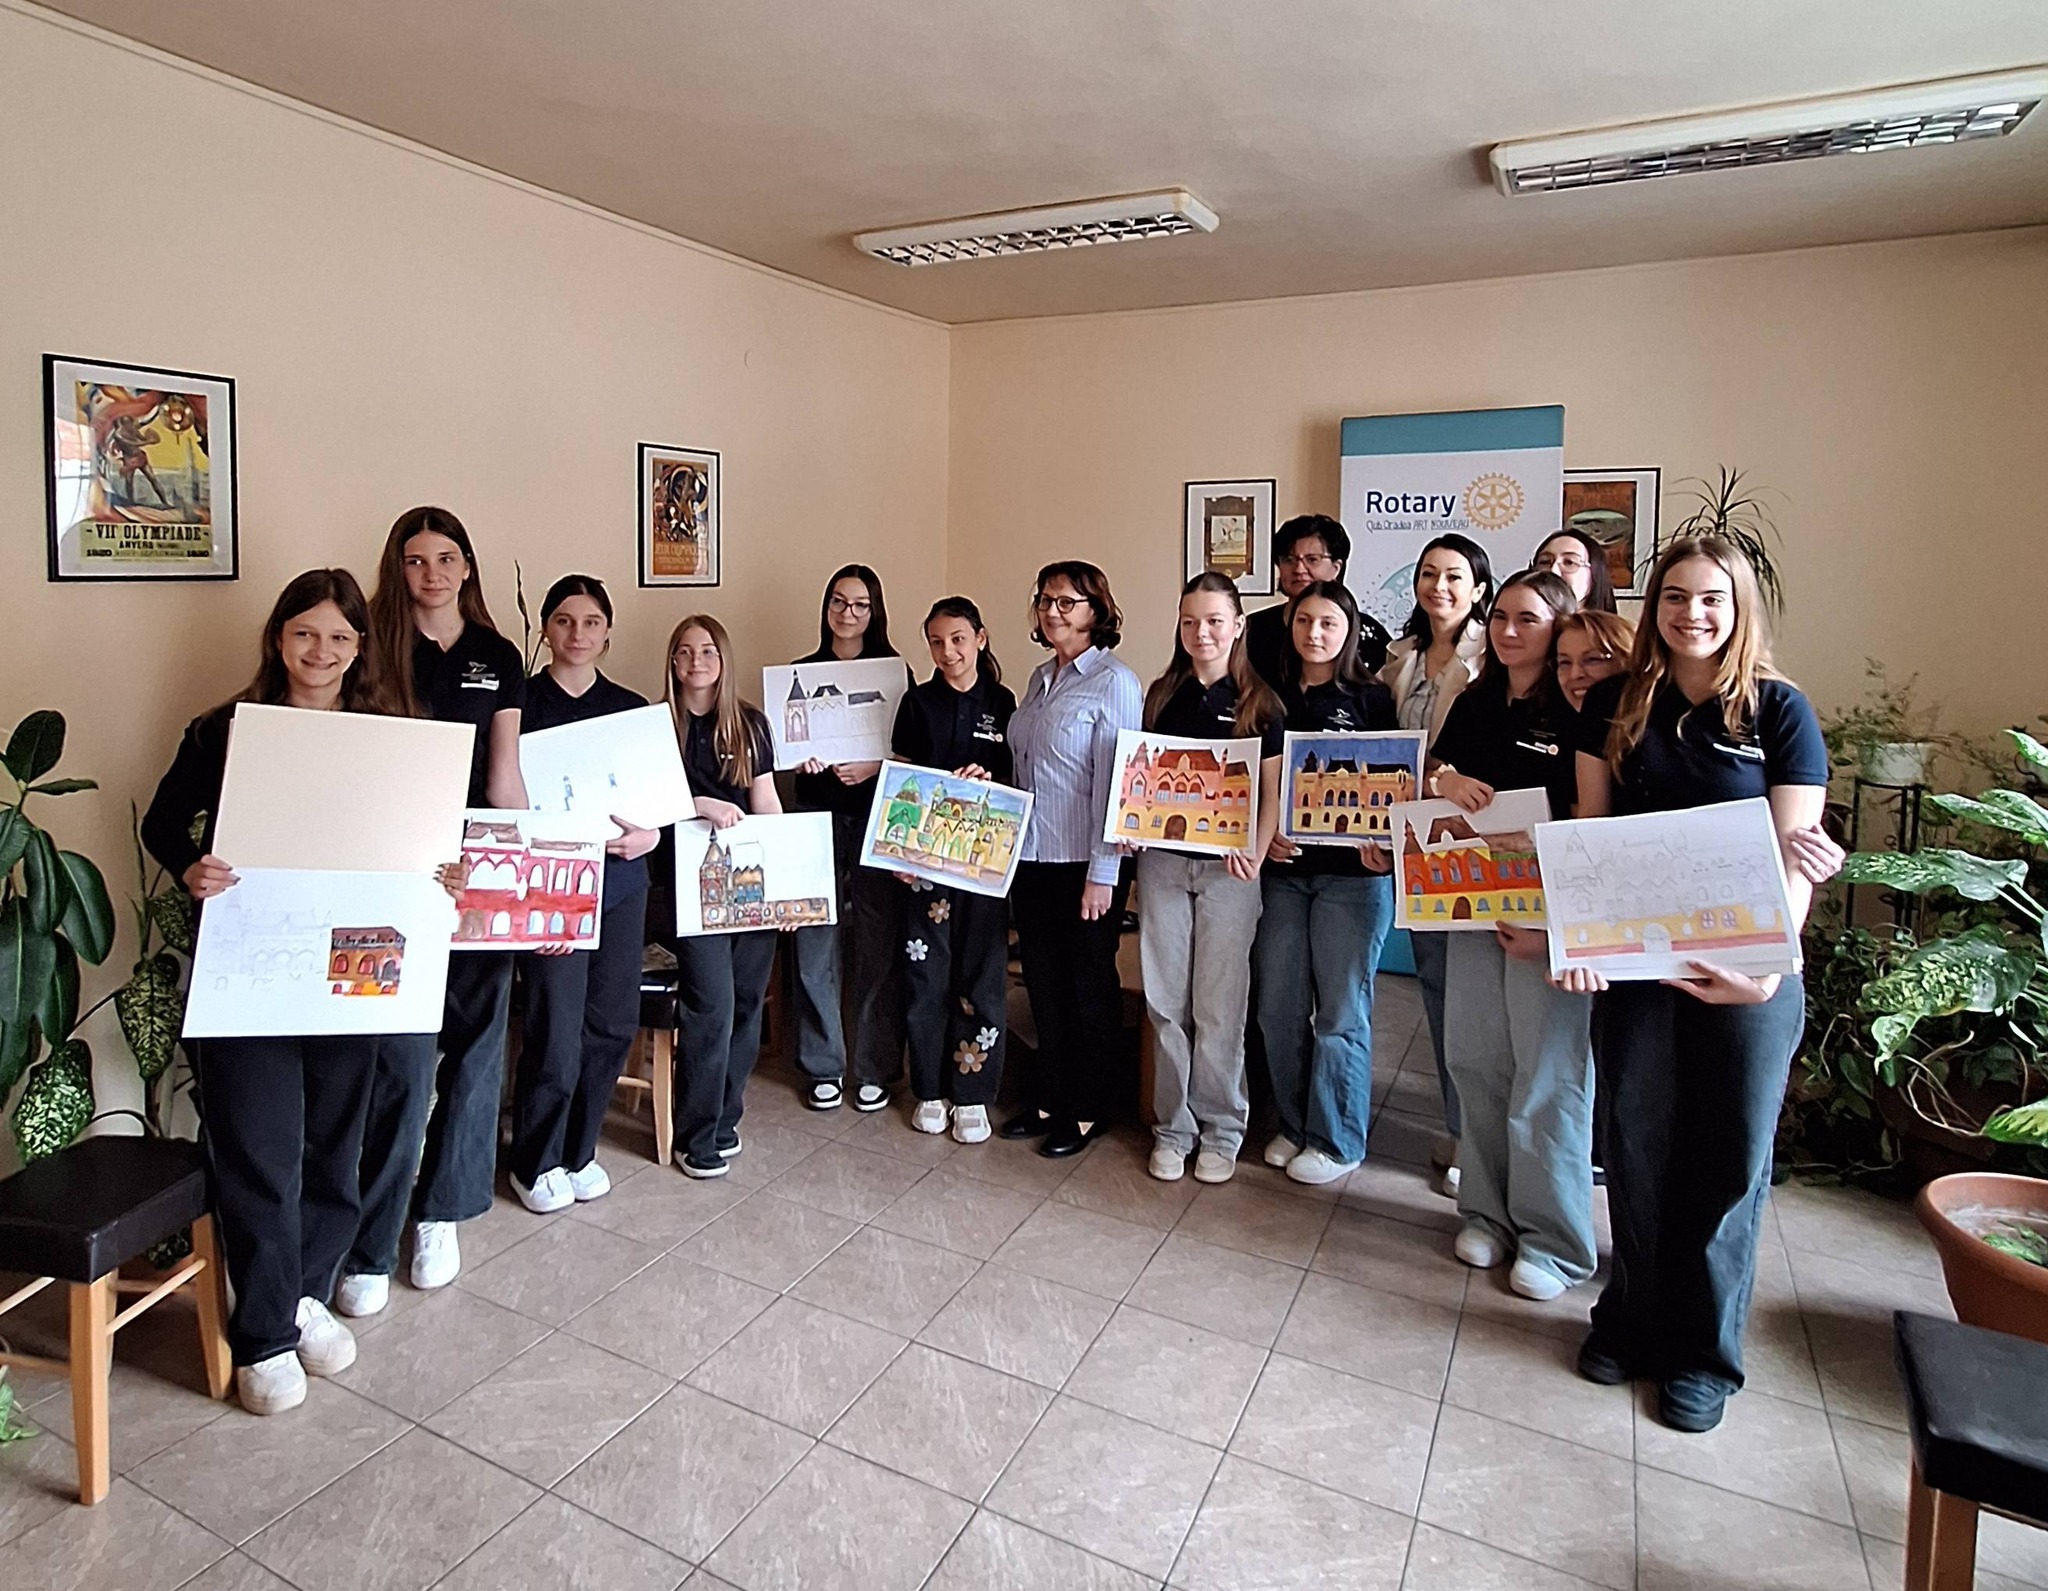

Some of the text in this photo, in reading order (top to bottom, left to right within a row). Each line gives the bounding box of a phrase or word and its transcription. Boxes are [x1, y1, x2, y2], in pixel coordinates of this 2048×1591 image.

[1366, 491, 1456, 517] Rotary
[1413, 520, 1428, 530] ART
[1430, 519, 1469, 530] NOUVEAU
[124, 525, 202, 541] OLYMPIADE
